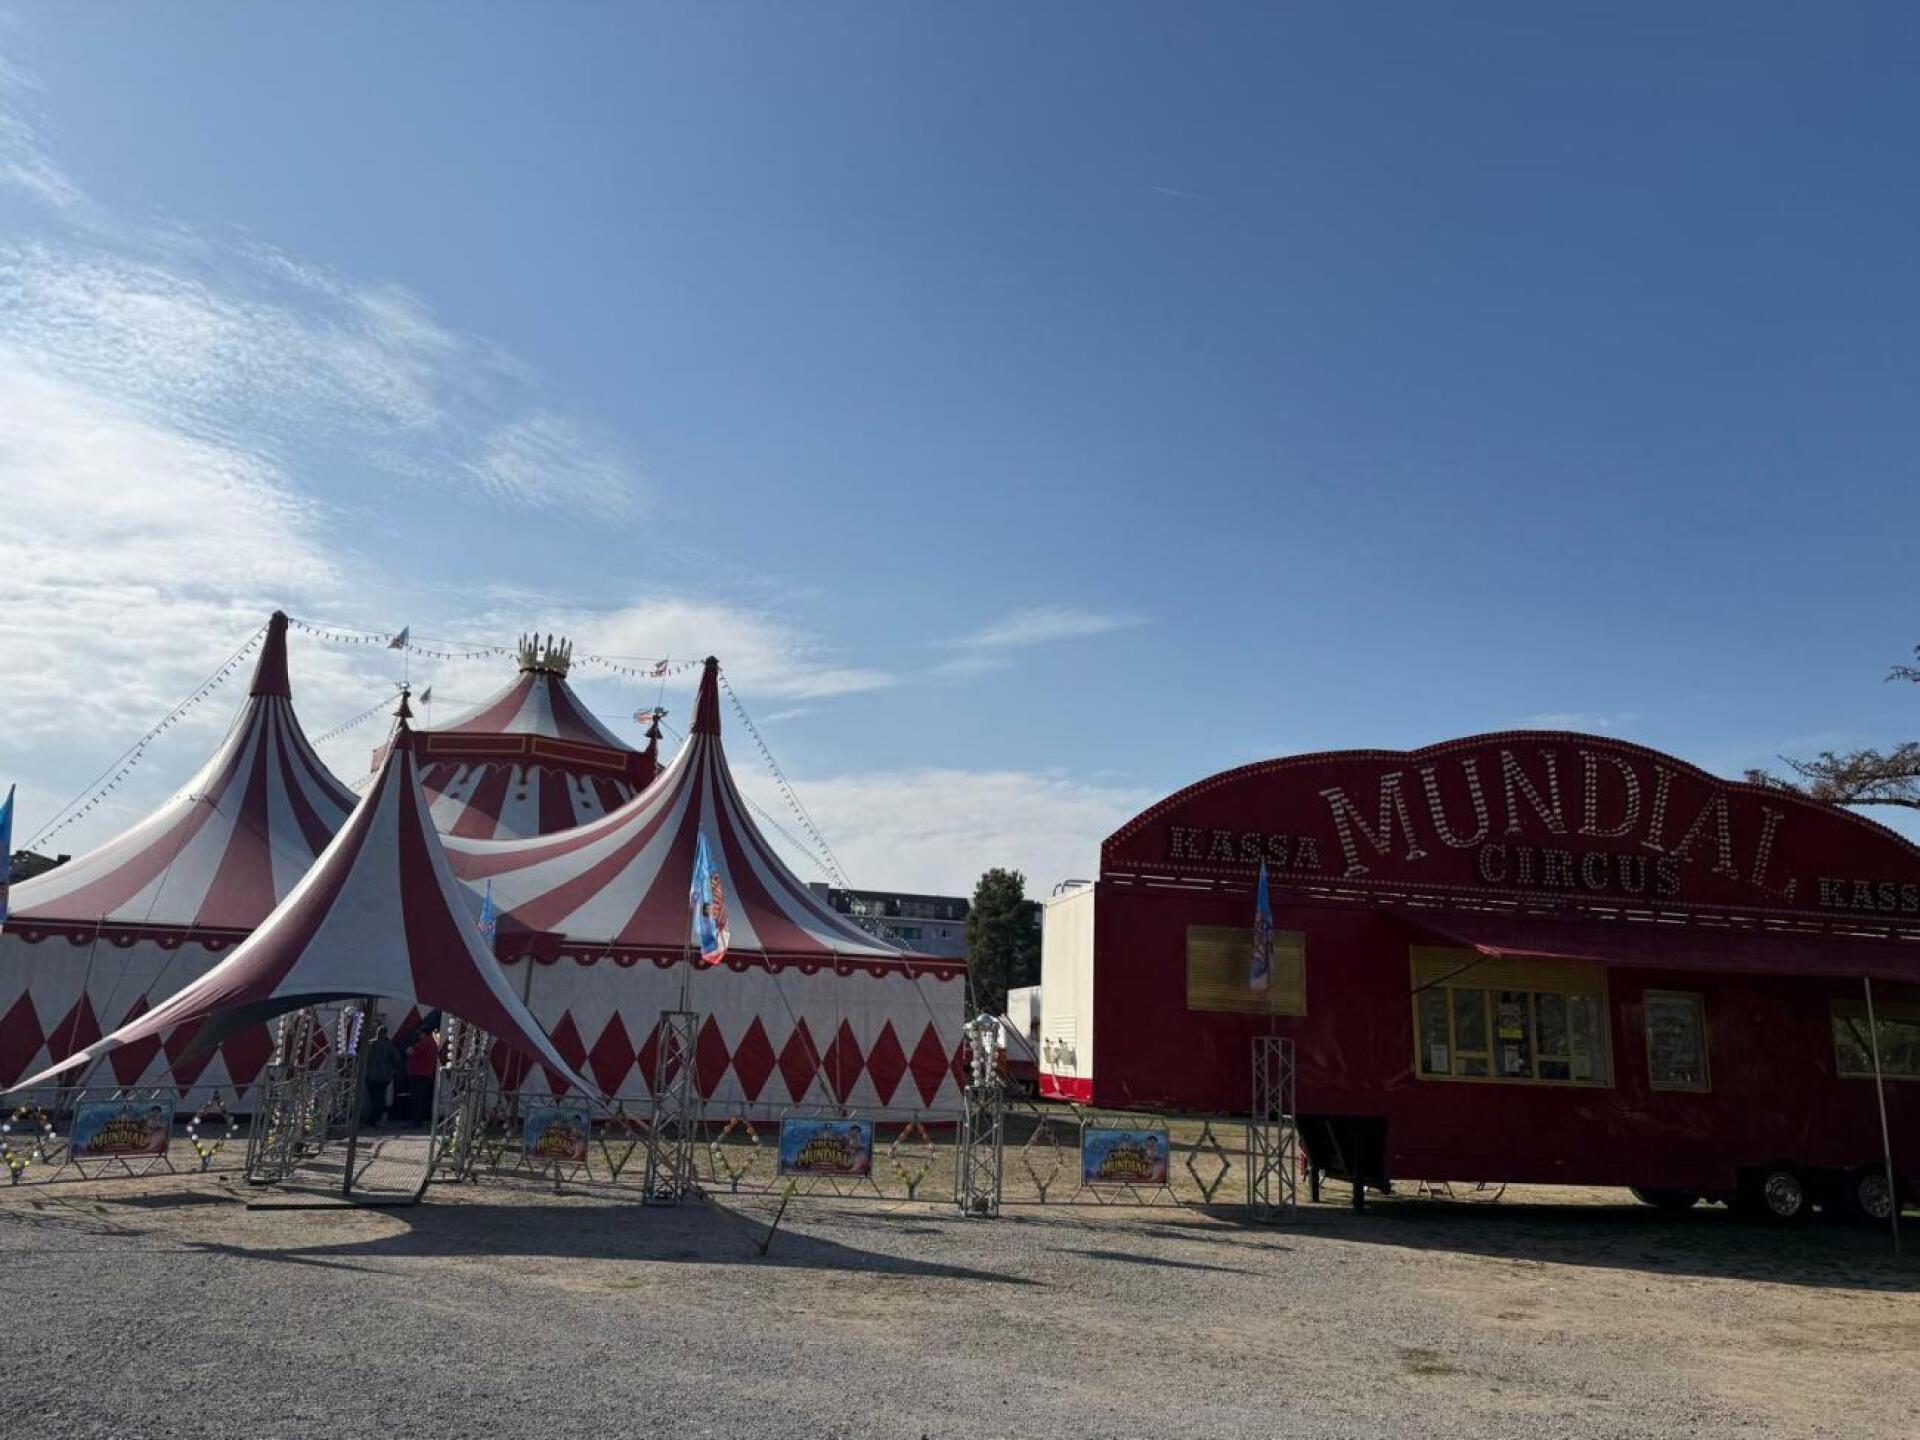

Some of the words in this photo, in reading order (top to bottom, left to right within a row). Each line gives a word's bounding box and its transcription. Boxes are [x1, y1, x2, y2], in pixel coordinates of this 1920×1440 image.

[1169, 825, 1322, 870] KASSA
[1319, 748, 1798, 904] MUNDIAL
[1478, 842, 1684, 897] CIRCUS
